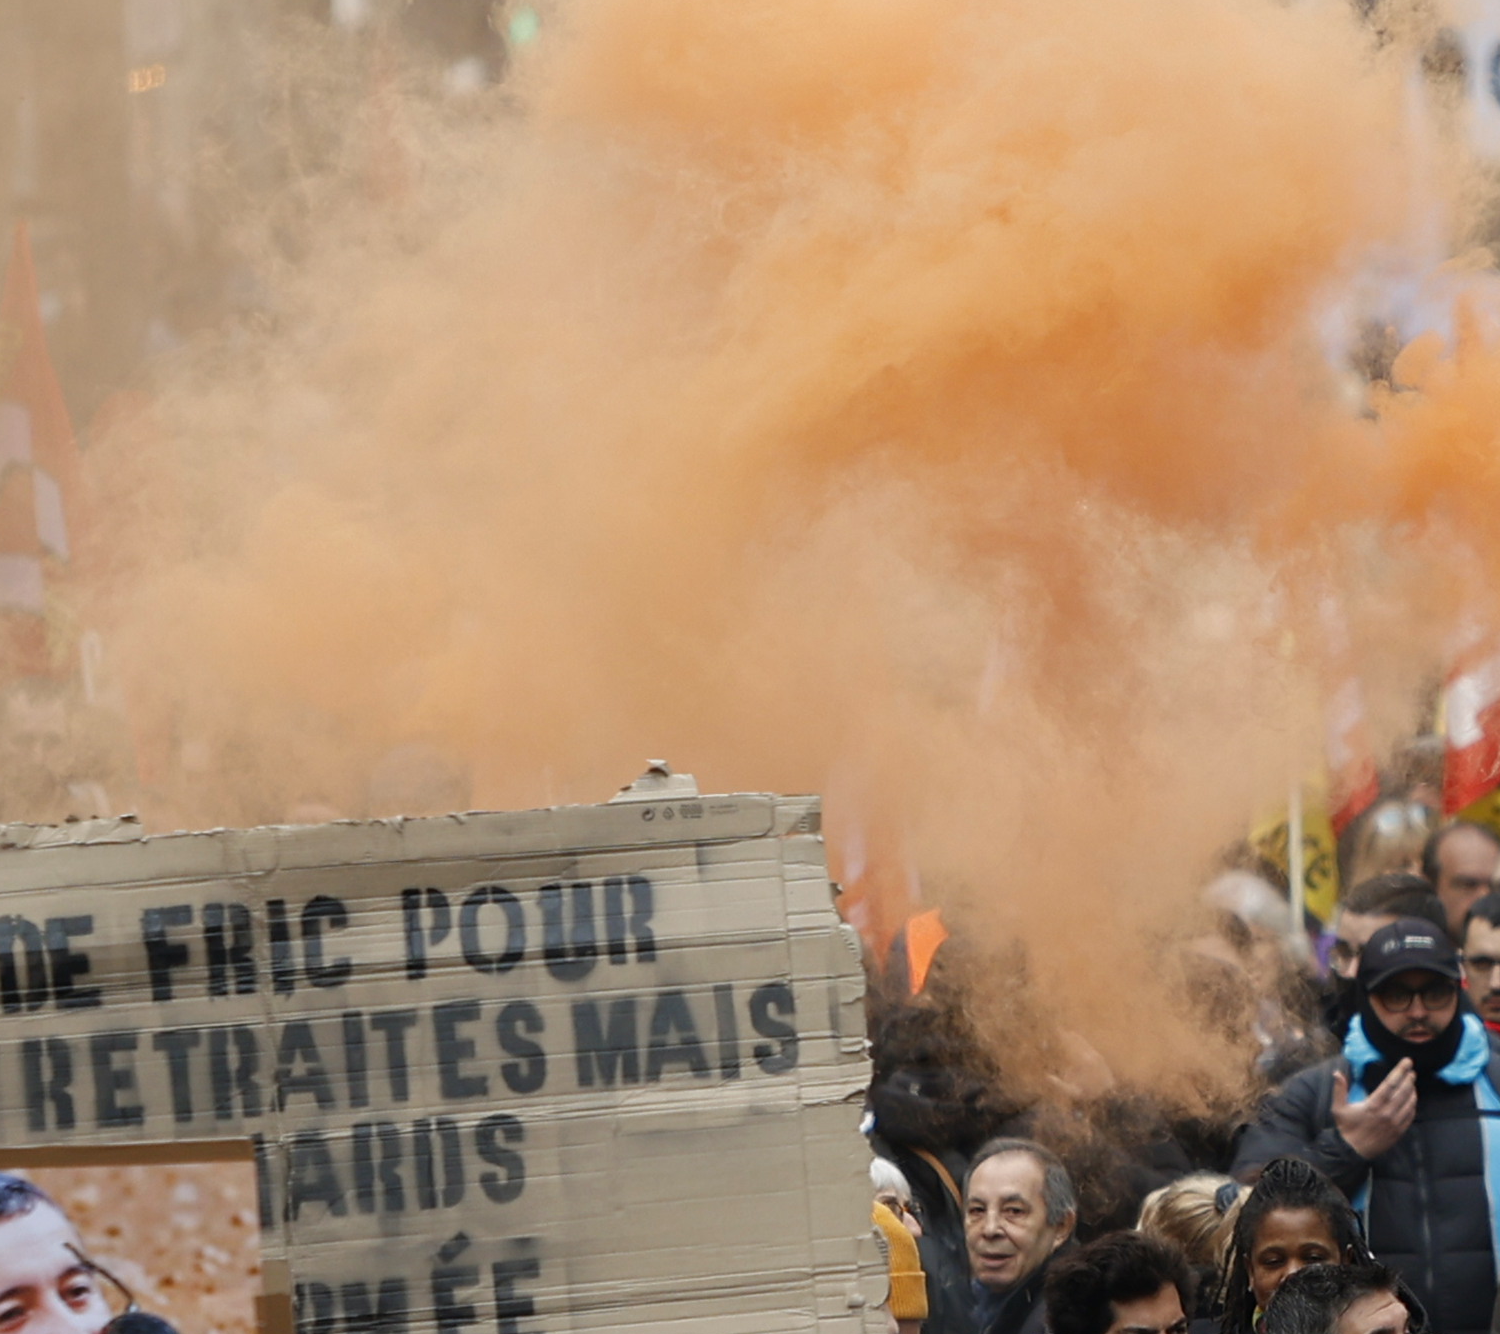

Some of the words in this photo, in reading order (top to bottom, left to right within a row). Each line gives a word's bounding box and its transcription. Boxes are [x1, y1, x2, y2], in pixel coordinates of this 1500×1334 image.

[142, 894, 354, 1002] FRIC
[402, 875, 657, 983] POUR
[21, 999, 547, 1132] RETRAITES
[571, 981, 800, 1088] MAIS
